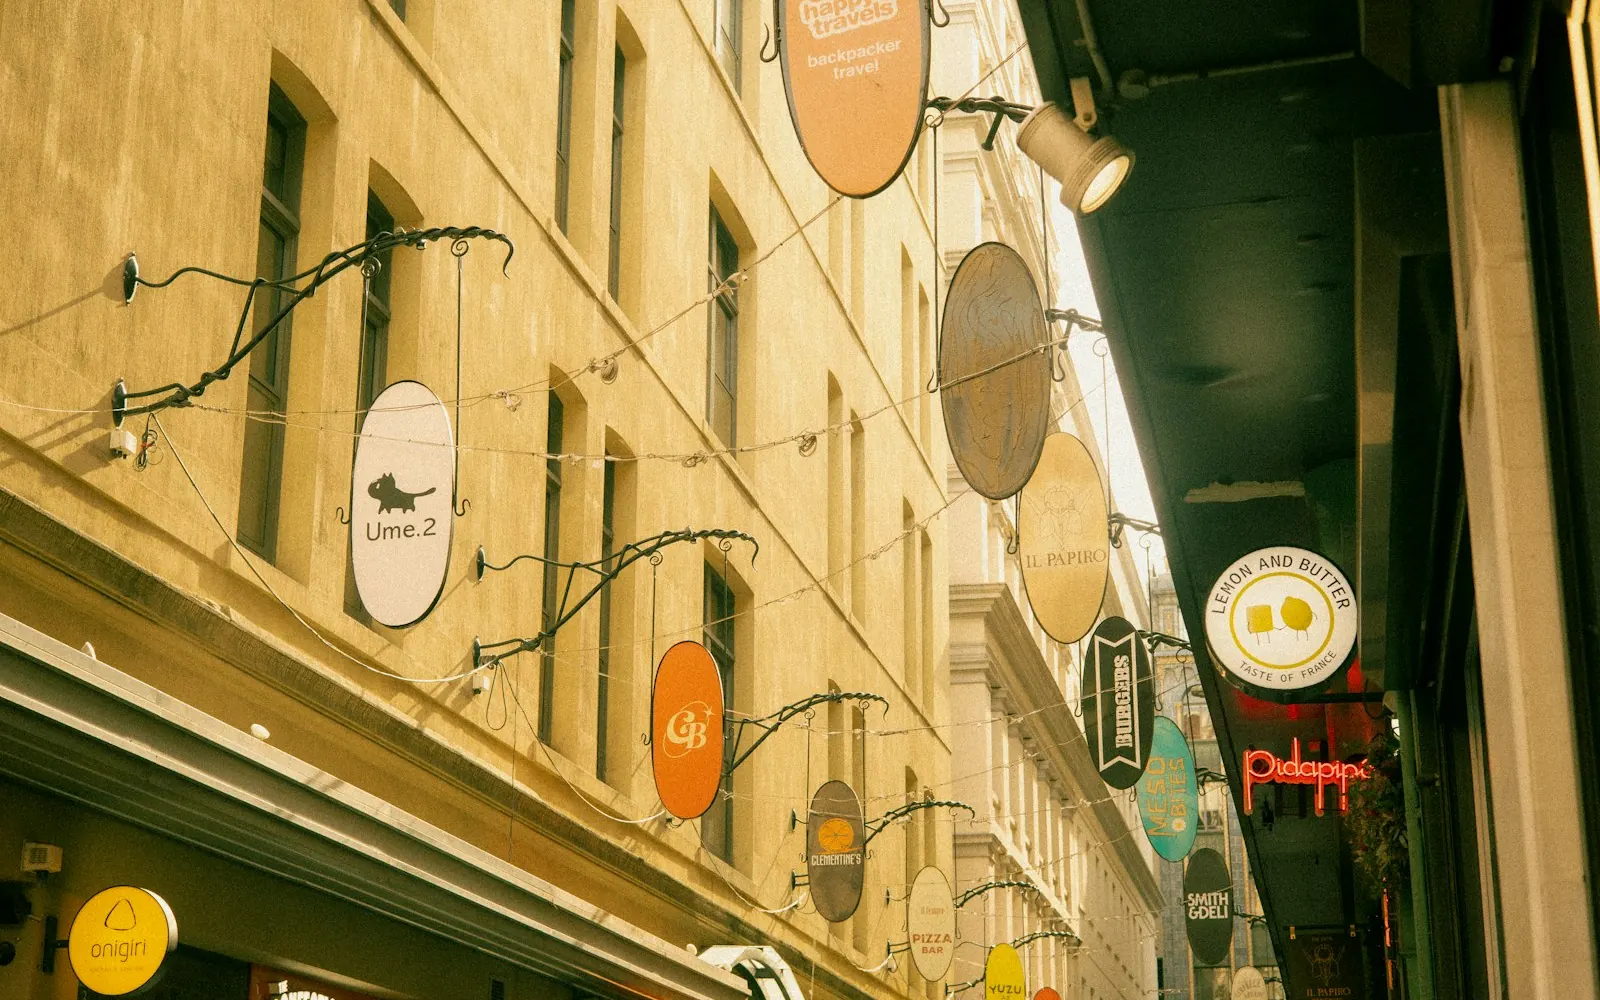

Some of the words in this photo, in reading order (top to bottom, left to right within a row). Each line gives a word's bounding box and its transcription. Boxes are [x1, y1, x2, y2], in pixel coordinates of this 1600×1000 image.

[813, 1, 894, 35] travels
[808, 39, 902, 68] backpacker
[833, 59, 879, 80] travel
[366, 517, 437, 541] Ume.2
[1026, 554, 1042, 568] IL
[1047, 548, 1107, 567] PAPIRO
[1211, 563, 1254, 615] LEMON
[1259, 554, 1293, 571] AND
[1299, 557, 1351, 610] BUTTER
[1239, 660, 1273, 682] TASTE
[1280, 673, 1295, 683] OF
[1301, 649, 1337, 679] FRANCE
[1113, 654, 1133, 748] BURGERS
[1169, 757, 1187, 817] BITES
[811, 853, 862, 866] CLEMENTINE'S
[1187, 892, 1229, 907] SMITH
[1188, 905, 1229, 920] &DELI
[91, 938, 147, 963] onigiri
[921, 946, 944, 954] BAR
[988, 984, 1022, 995] YUZU
